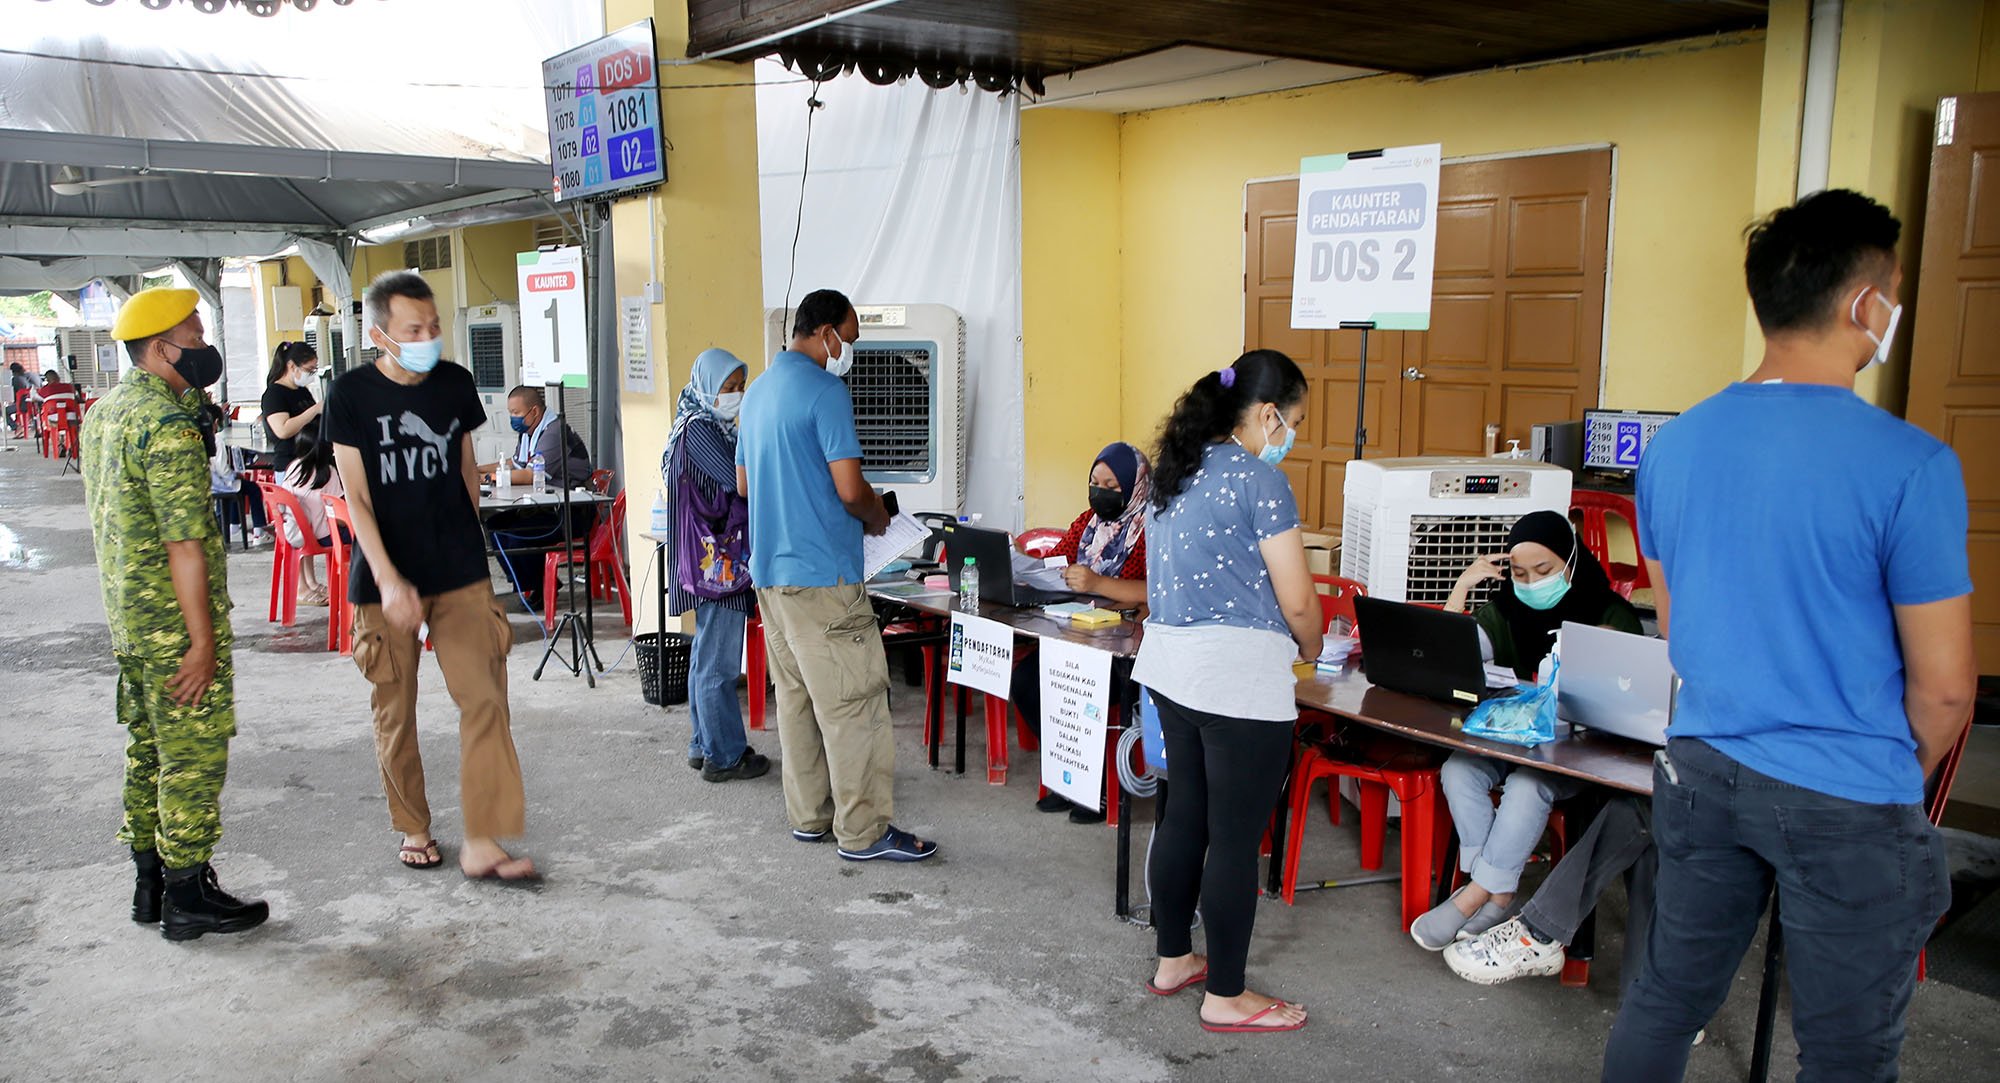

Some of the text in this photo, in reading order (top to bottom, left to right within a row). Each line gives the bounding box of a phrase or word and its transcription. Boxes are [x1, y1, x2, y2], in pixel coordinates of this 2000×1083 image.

[605, 52, 643, 87] DOS 1
[552, 75, 592, 102] 1077 02
[555, 104, 594, 132] 1078 01
[608, 92, 647, 133] 1081
[558, 134, 597, 160] 1079 02
[621, 136, 643, 173] 02
[560, 164, 600, 189] 1080 01
[1331, 191, 1401, 210] KAUNTER
[1311, 208, 1420, 229] PENDAFTARAN
[1310, 238, 1417, 282] DOS 2
[534, 275, 568, 289] KAUNTER
[544, 298, 560, 363] 1
[376, 415, 395, 446] I
[1592, 421, 1612, 431] 2189
[1620, 425, 1638, 434] DOS
[1591, 433, 1612, 442] 2190
[1619, 434, 1637, 461] 2
[1591, 444, 1611, 453] 2191
[380, 446, 438, 485] NYC
[1590, 455, 1611, 464] 2192
[964, 637, 1010, 661] PENDAFTARAN
[1065, 660, 1080, 670] SILA
[1049, 668, 1096, 687] SEDIAKAN KAD
[1050, 680, 1093, 698] PENGENALAN
[1063, 696, 1076, 706] DAN
[1060, 708, 1079, 719] BUKTI
[1049, 715, 1081, 733] TEMUJANJI
[1058, 731, 1079, 743] DALAM
[1056, 742, 1082, 757] APLIKASI
[1049, 750, 1089, 772] MYSEJAHTERA
